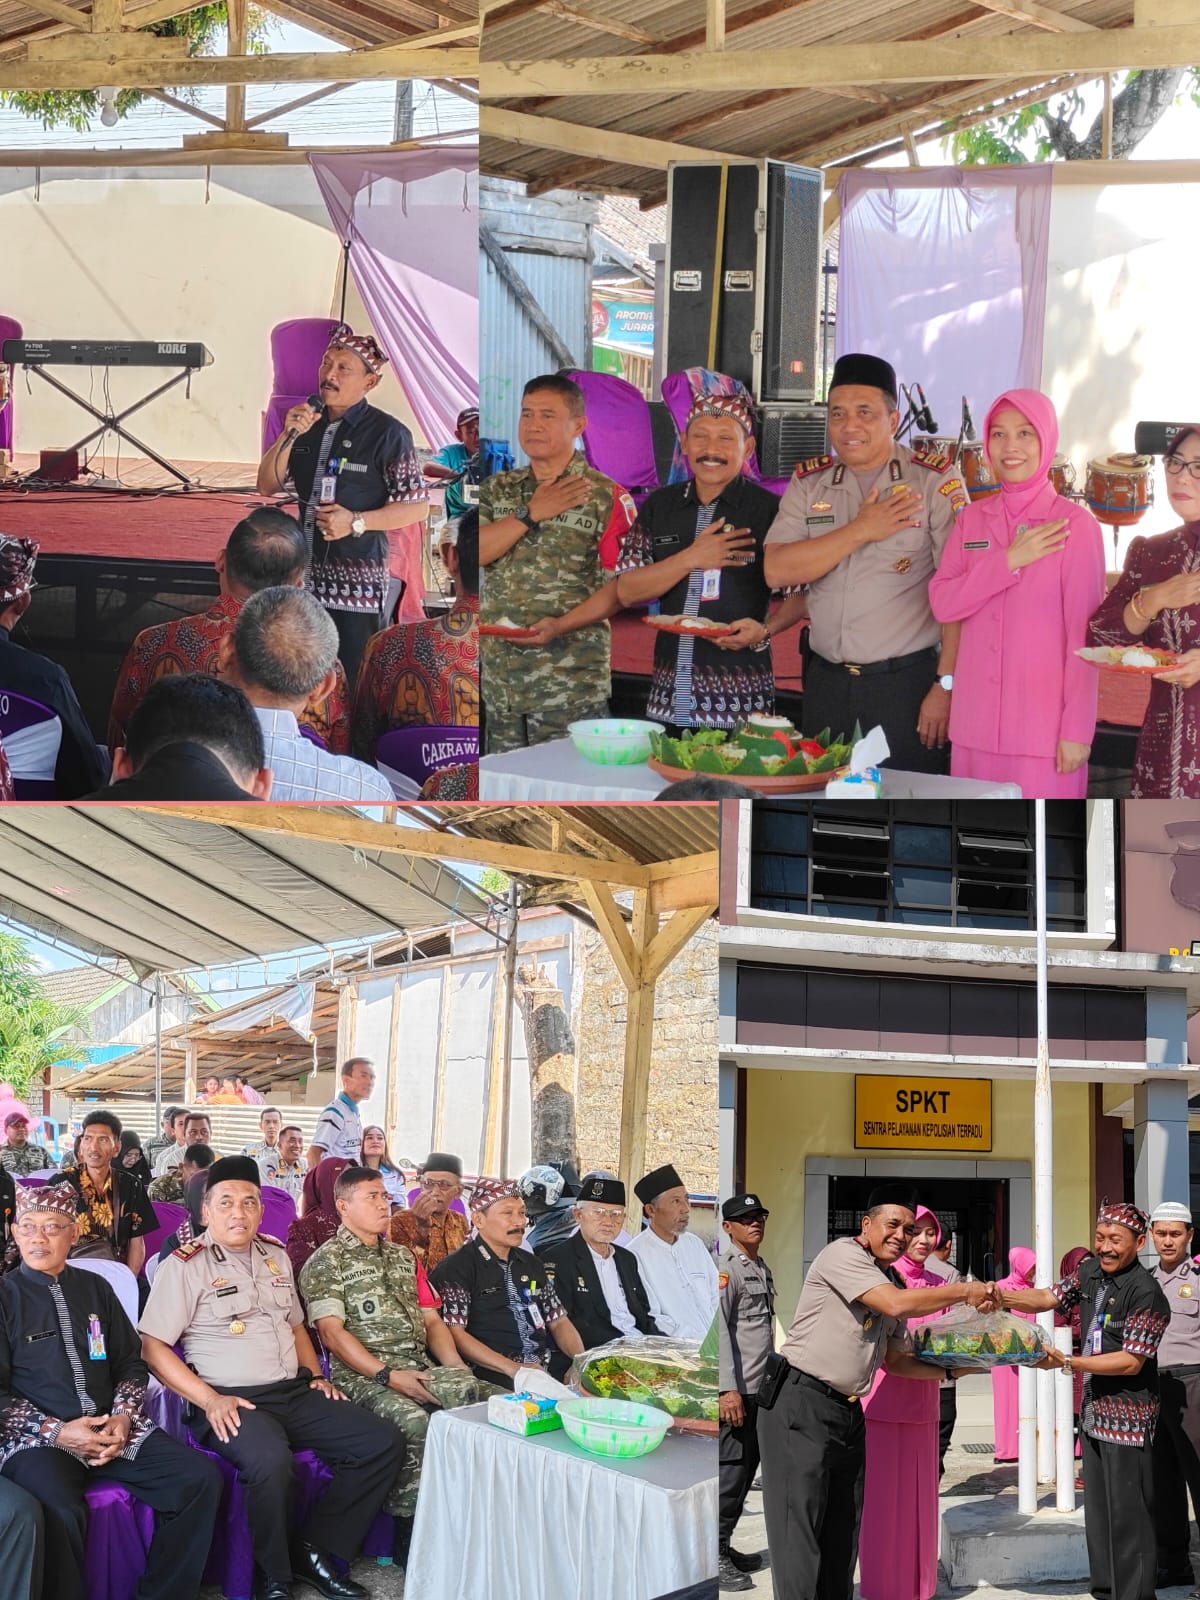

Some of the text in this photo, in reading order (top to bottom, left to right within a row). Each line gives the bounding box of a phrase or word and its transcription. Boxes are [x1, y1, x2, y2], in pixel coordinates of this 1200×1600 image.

[157, 343, 187, 355] KORG
[574, 517, 593, 529] AD
[895, 1089, 951, 1114] SPKT
[863, 1121, 983, 1139] SENTRA PELAYANAN KEPOLISIAN TERPADU
[341, 1267, 376, 1281] MUHTAROM
